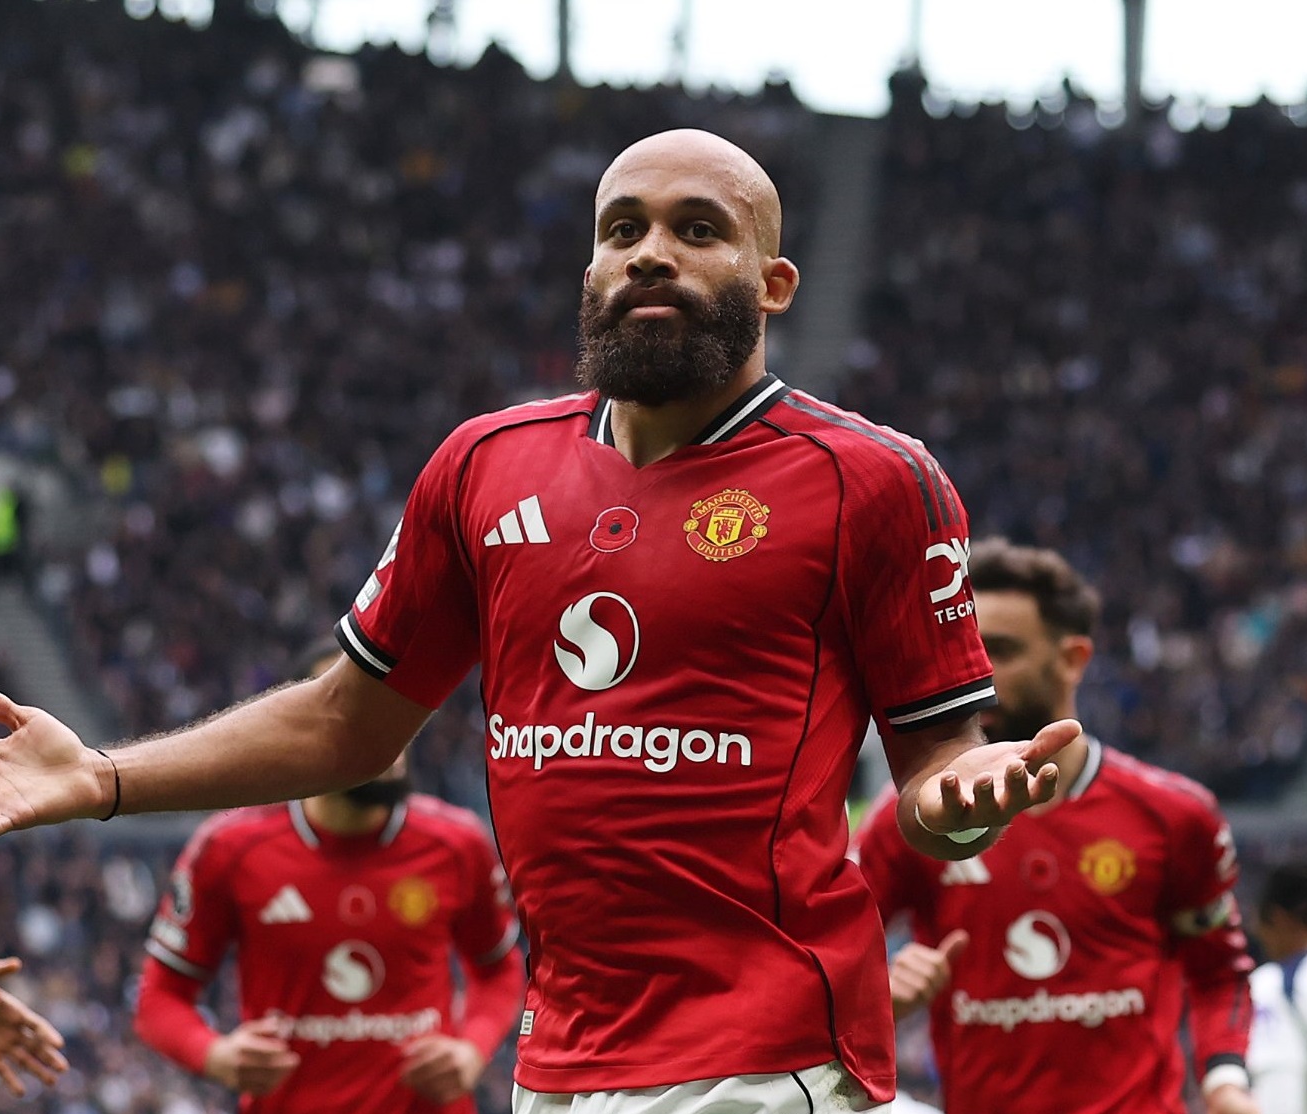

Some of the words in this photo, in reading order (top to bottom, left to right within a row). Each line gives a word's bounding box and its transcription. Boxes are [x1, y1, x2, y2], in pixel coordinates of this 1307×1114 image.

[697, 493, 764, 520] MANCHESTER
[696, 541, 744, 556] UNITED
[489, 711, 752, 773] Snapdragon
